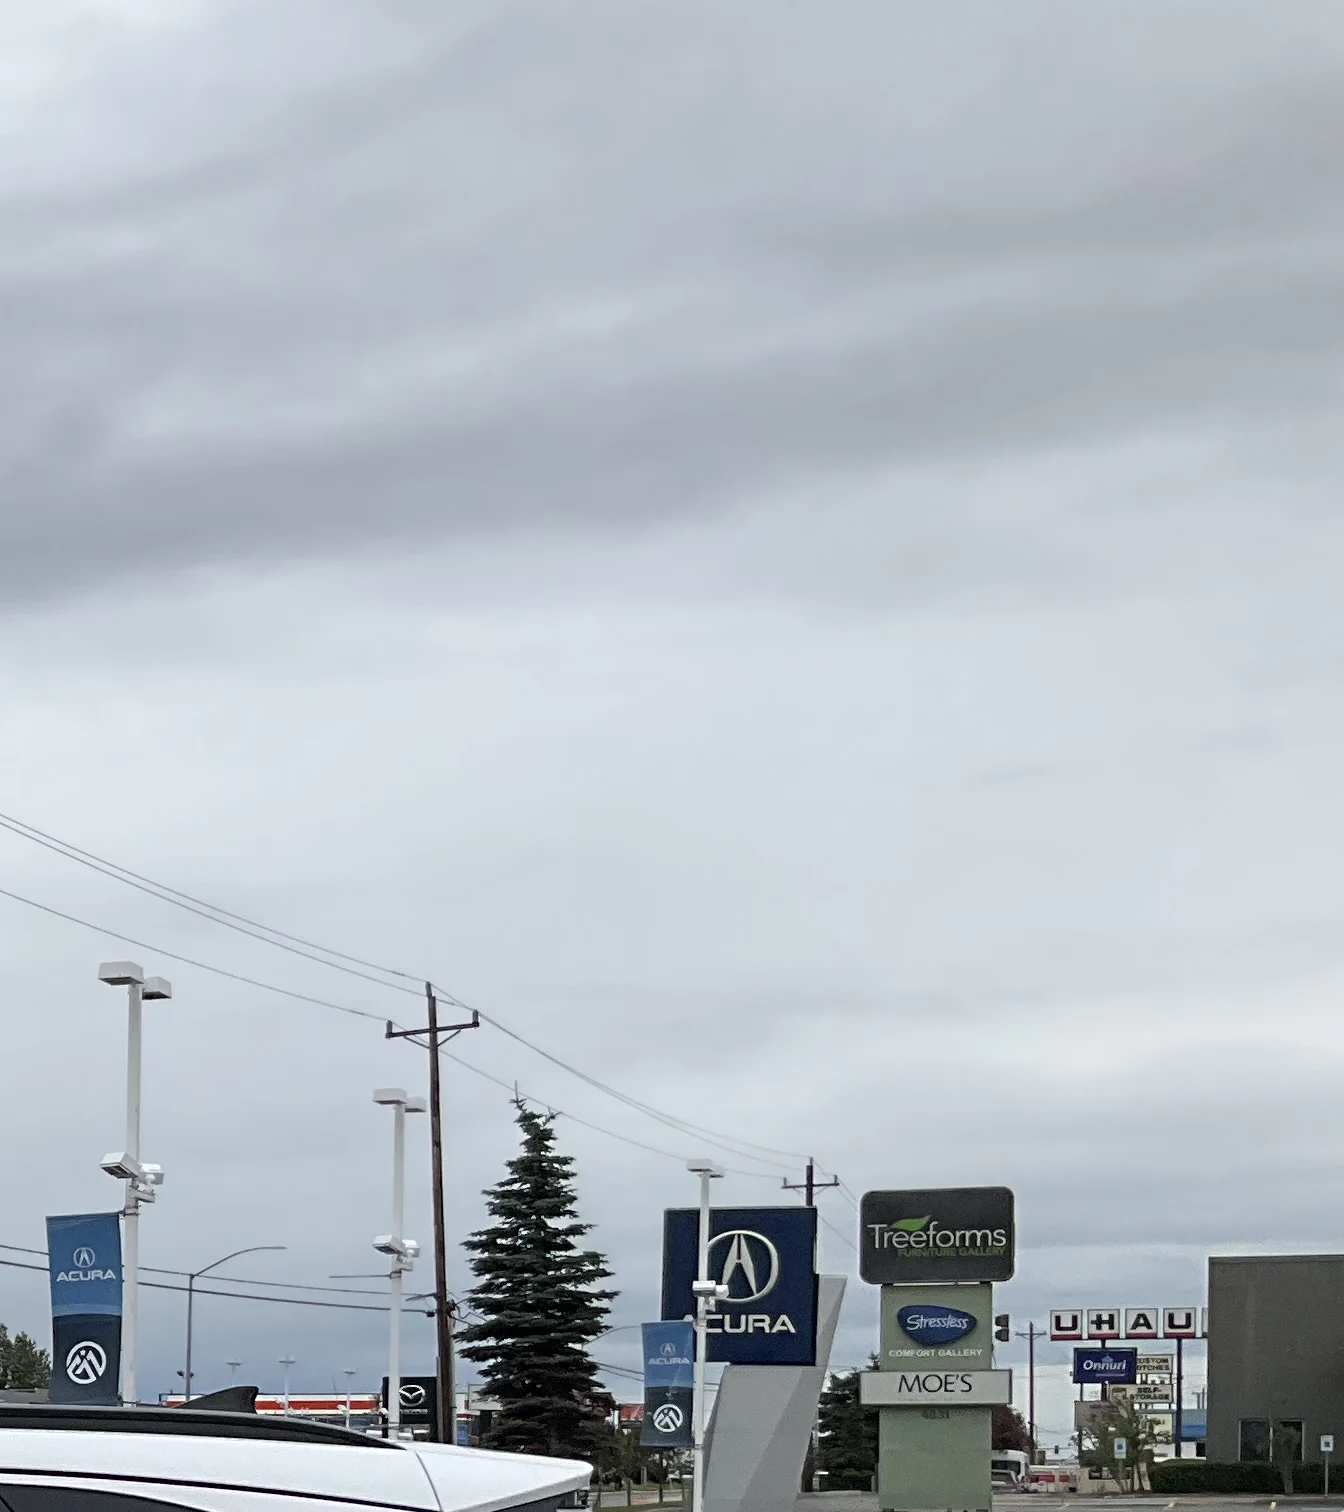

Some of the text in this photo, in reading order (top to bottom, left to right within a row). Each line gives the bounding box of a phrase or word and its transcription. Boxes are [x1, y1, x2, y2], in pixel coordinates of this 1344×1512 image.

[866, 1221, 1007, 1249] Treeforms
[958, 1247, 1006, 1257] GALLERY
[56, 1269, 117, 1283] ACURA
[906, 1314, 969, 1331] Stressless
[888, 1348, 984, 1358] COMFORT GALLERY
[648, 1357, 690, 1365] ACURA
[897, 1373, 973, 1394] MOE'S
